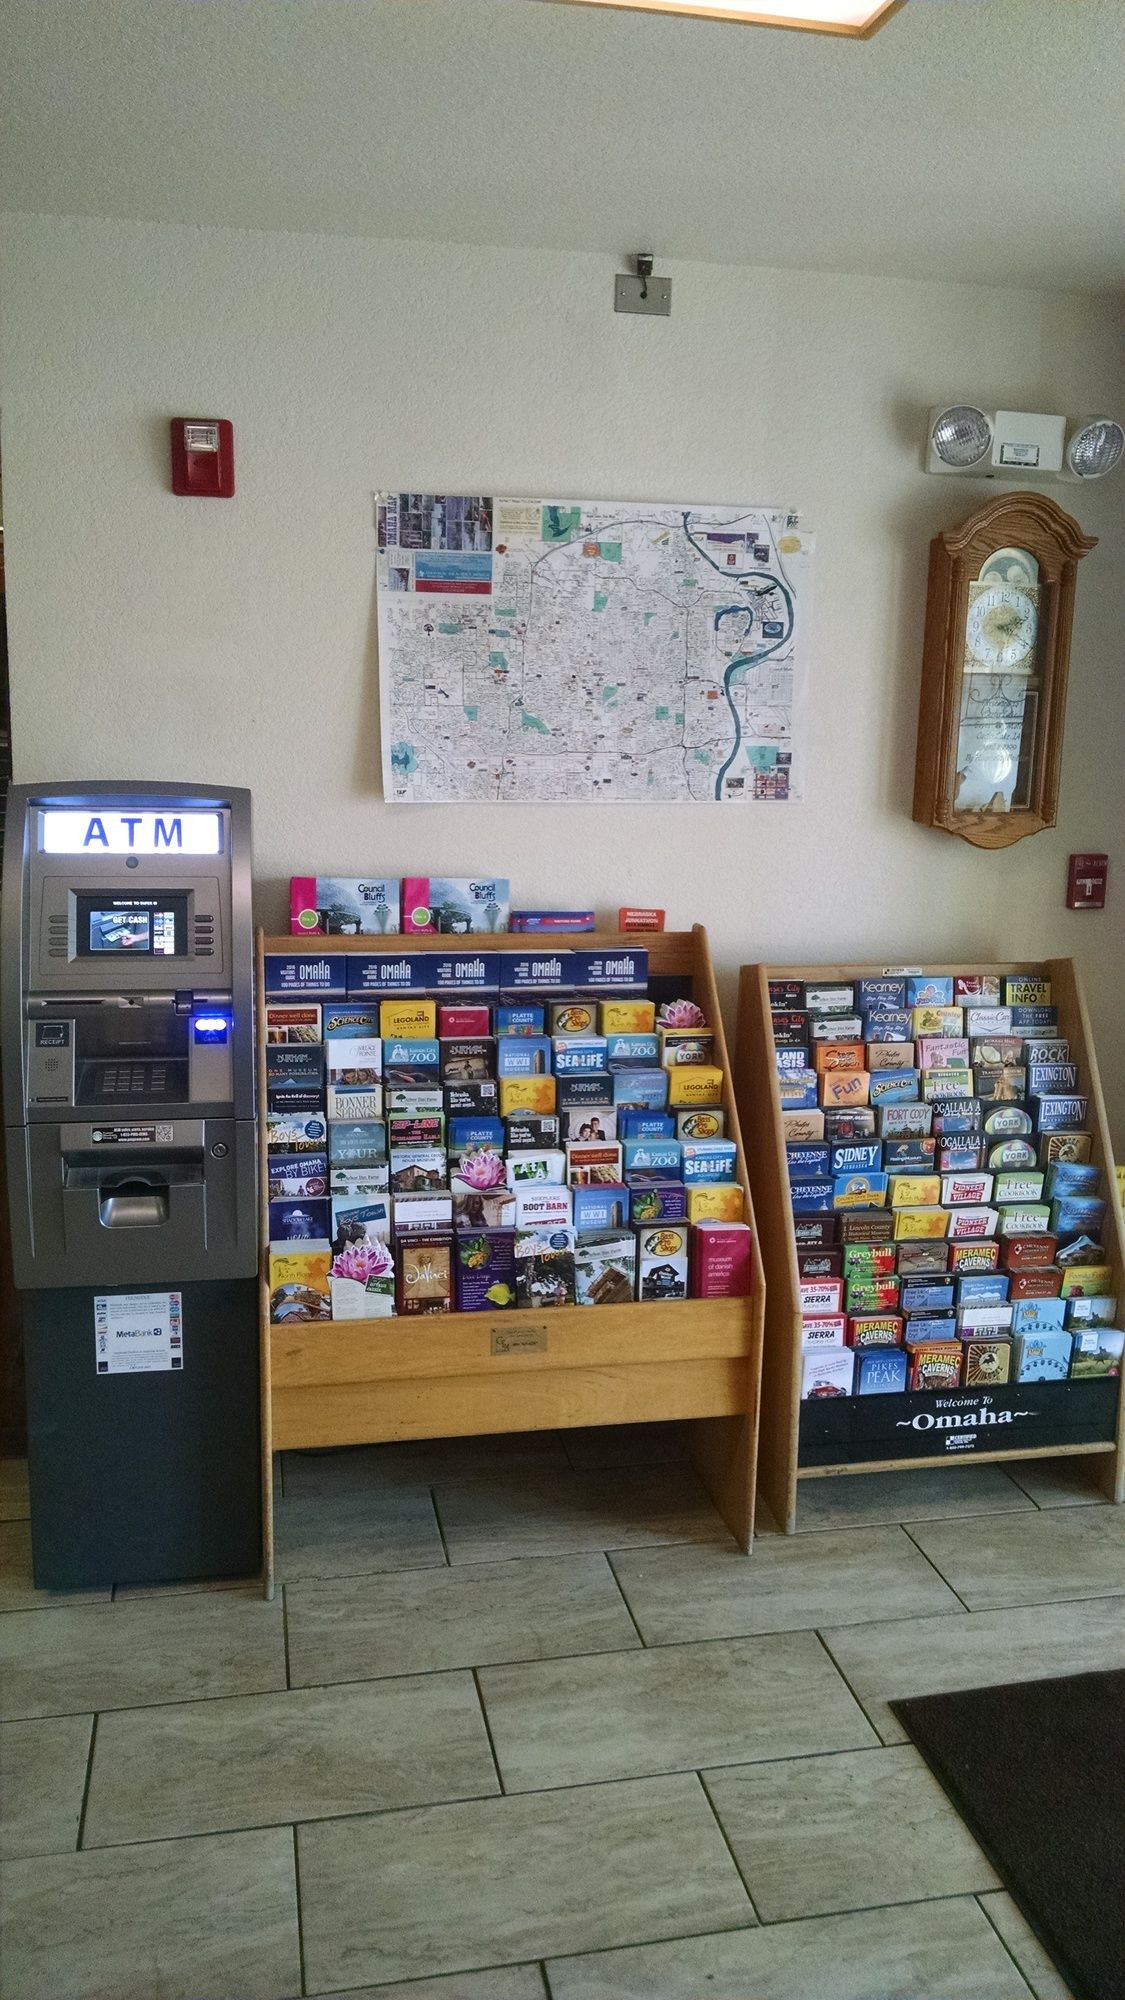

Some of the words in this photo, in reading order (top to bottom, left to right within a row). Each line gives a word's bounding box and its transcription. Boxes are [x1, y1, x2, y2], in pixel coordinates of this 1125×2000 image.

[387, 516, 397, 546] OMAHA
[987, 595, 995, 606] 11
[1001, 592, 1010, 603] 12
[976, 606, 986, 618] 10
[1024, 608, 1030, 620] 2
[972, 621, 980, 632] 9
[1026, 622, 1032, 633] 3
[974, 636, 980, 648] 8
[985, 648, 990, 659] 7
[996, 651, 1003, 662] 6
[1010, 648, 1016, 660] 5
[82, 817, 183, 848] ATM
[358, 884, 385, 893] Council
[469, 882, 496, 892] Council
[364, 892, 386, 904] Bluffs
[474, 891, 496, 902] Bluffs
[112, 916, 127, 924] GET
[128, 916, 148, 924] CASH
[300, 960, 330, 980] OMAHA
[380, 960, 412, 980] OMAHA
[455, 958, 485, 978] OMAHA
[532, 958, 562, 976] OMAHA
[606, 956, 635, 975] OMAHA
[787, 984, 800, 993] City
[862, 981, 905, 994] Kearney
[1011, 984, 1047, 993] TRAVEL
[1011, 994, 1038, 1002] INFO
[393, 1016, 430, 1024] LEGOLAND
[791, 1015, 804, 1025] City
[869, 1010, 912, 1022] Kearney
[971, 1012, 995, 1021] Classic
[572, 1019, 588, 1027] Shops
[631, 1047, 656, 1056] ZOO
[926, 1042, 966, 1052] Fantastic
[409, 1053, 436, 1063] ZOO
[679, 1052, 704, 1060] YORK
[776, 1052, 804, 1060] LAND
[1030, 1049, 1068, 1060] ROCK
[556, 1054, 579, 1068] SEA
[1032, 1066, 1076, 1087] LEXINGTON
[831, 1078, 862, 1100] Fun
[933, 1082, 959, 1091] Free
[927, 1090, 966, 1099] COOKBOOK
[335, 1096, 376, 1109] BONNER
[933, 1102, 973, 1113] OGALLALA
[336, 1107, 376, 1118] SPRINGS
[887, 1109, 908, 1120] FORT
[910, 1109, 930, 1120] CODY
[1041, 1101, 1086, 1122] LEXINGTON
[392, 1119, 439, 1129] ZIP-LINE
[996, 1119, 1020, 1127] YORK
[271, 1130, 297, 1143] Boys
[940, 1136, 980, 1147] OGALLALA
[294, 1136, 326, 1152] Town
[650, 1156, 678, 1166] ZOO
[786, 1151, 827, 1160] CHEYENNE
[834, 1145, 879, 1169] SIDNEY
[1005, 1152, 1027, 1160] YORK
[271, 1162, 298, 1174] EXPLORE
[300, 1158, 321, 1168] OMAHA
[286, 1170, 298, 1179] BY
[301, 1162, 327, 1177] BIKE!
[685, 1160, 707, 1175] SEA
[790, 1185, 832, 1195] CHEYENNE
[954, 1183, 984, 1191] PIONEER
[1007, 1179, 1033, 1190] Free
[953, 1192, 982, 1200] VILLAGE
[999, 1189, 1038, 1197] COOKBOOK
[361, 1208, 384, 1217] Town
[1014, 1211, 1040, 1222] Free
[957, 1217, 988, 1225] PIONEER
[955, 1226, 986, 1235] VILLAGE
[516, 1244, 543, 1257] Boys
[849, 1248, 892, 1260] Greybull
[956, 1248, 997, 1260] MERAMEC
[958, 1257, 990, 1271] CAVERNS
[406, 1263, 448, 1284] DaVinci
[852, 1281, 895, 1294] Greybull
[803, 1296, 831, 1304] SIERRA
[855, 1321, 898, 1334] MERAMEC
[116, 1330, 153, 1338] MetaBank
[808, 1331, 835, 1339] SIERRA
[860, 1330, 893, 1343] CAVERNS
[919, 1354, 960, 1366] MERAMEC
[871, 1363, 898, 1371] PIKES
[922, 1363, 954, 1375] CAVERNS
[867, 1370, 901, 1384] PEAK
[935, 1397, 979, 1408] Welcome
[982, 1396, 993, 1405] To
